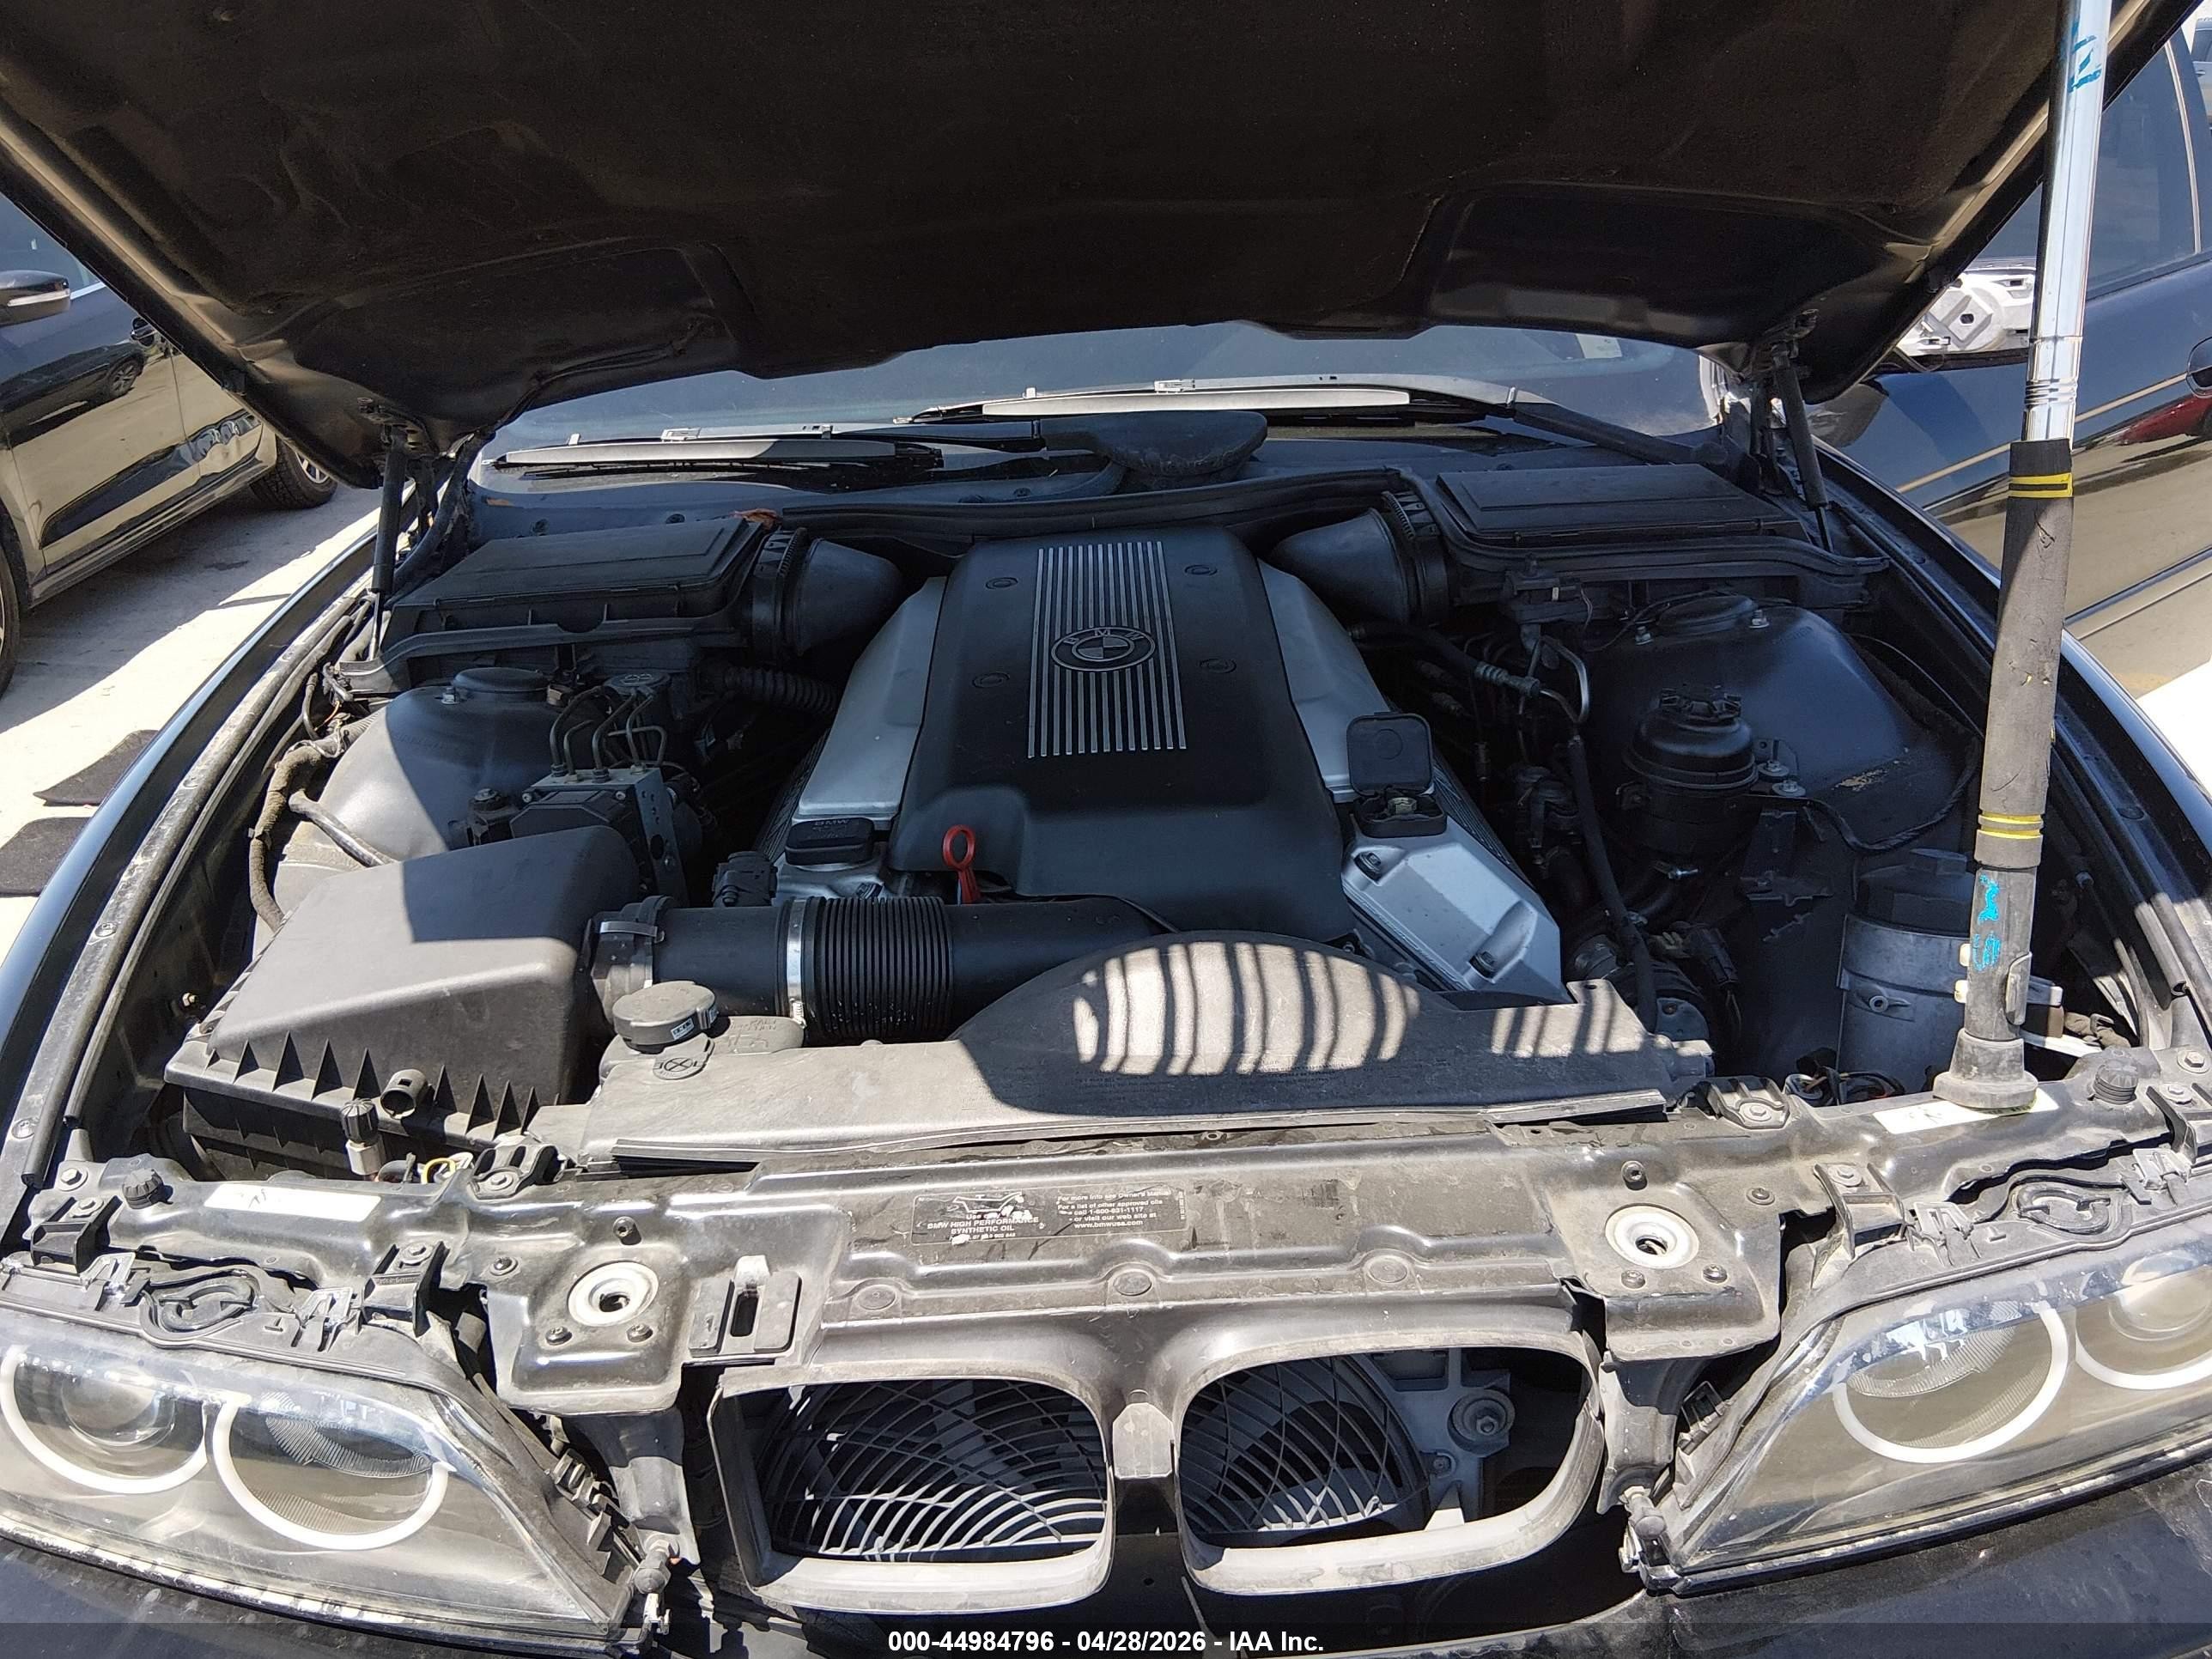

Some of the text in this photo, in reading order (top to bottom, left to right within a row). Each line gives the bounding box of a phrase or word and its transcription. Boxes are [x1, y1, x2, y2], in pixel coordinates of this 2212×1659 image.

[1117, 1200, 1149, 1208] approved
[927, 1221, 949, 1230] BMW
[1073, 1219, 1144, 1229] www.bmwusa.com
[951, 1225, 999, 1235] SYNTHETIC
